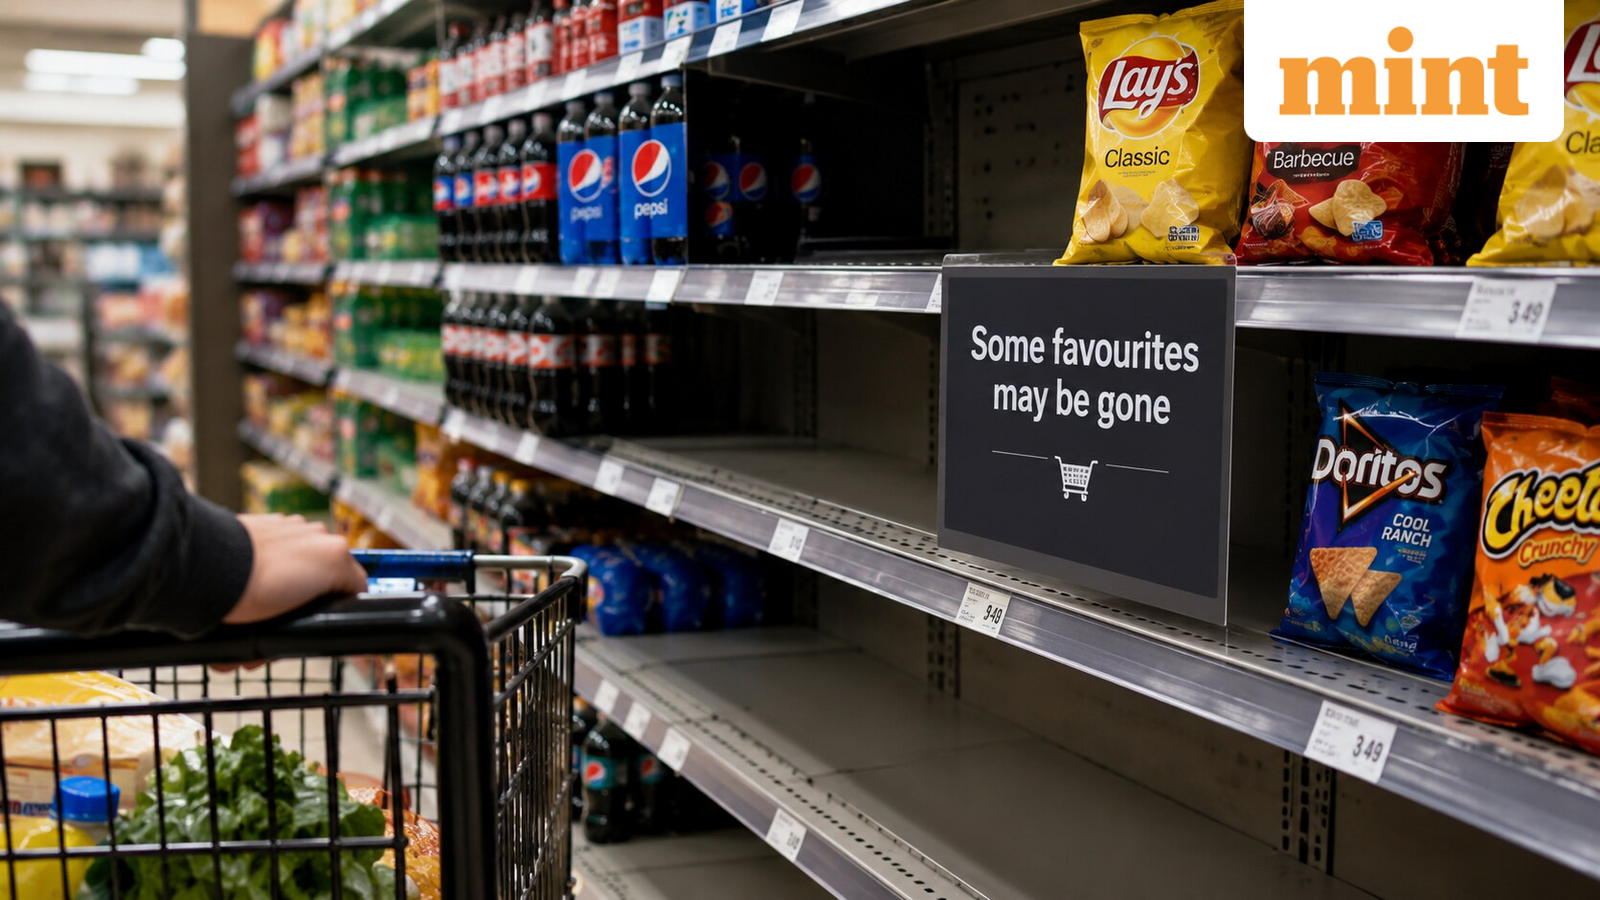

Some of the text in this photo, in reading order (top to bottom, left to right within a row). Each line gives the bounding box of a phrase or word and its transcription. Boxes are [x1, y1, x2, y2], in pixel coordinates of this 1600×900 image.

[1102, 57, 1194, 120] Lay's
[1105, 146, 1170, 168] Classic
[1273, 149, 1355, 169] Barbecue
[633, 198, 668, 220] pepsi
[971, 324, 1199, 373] Some favourites
[993, 377, 1171, 430] may be gone
[1311, 438, 1447, 499] Doritos
[1392, 513, 1430, 532] COOL
[1381, 526, 1432, 548] RANCH
[1519, 535, 1597, 566] Crunchy
